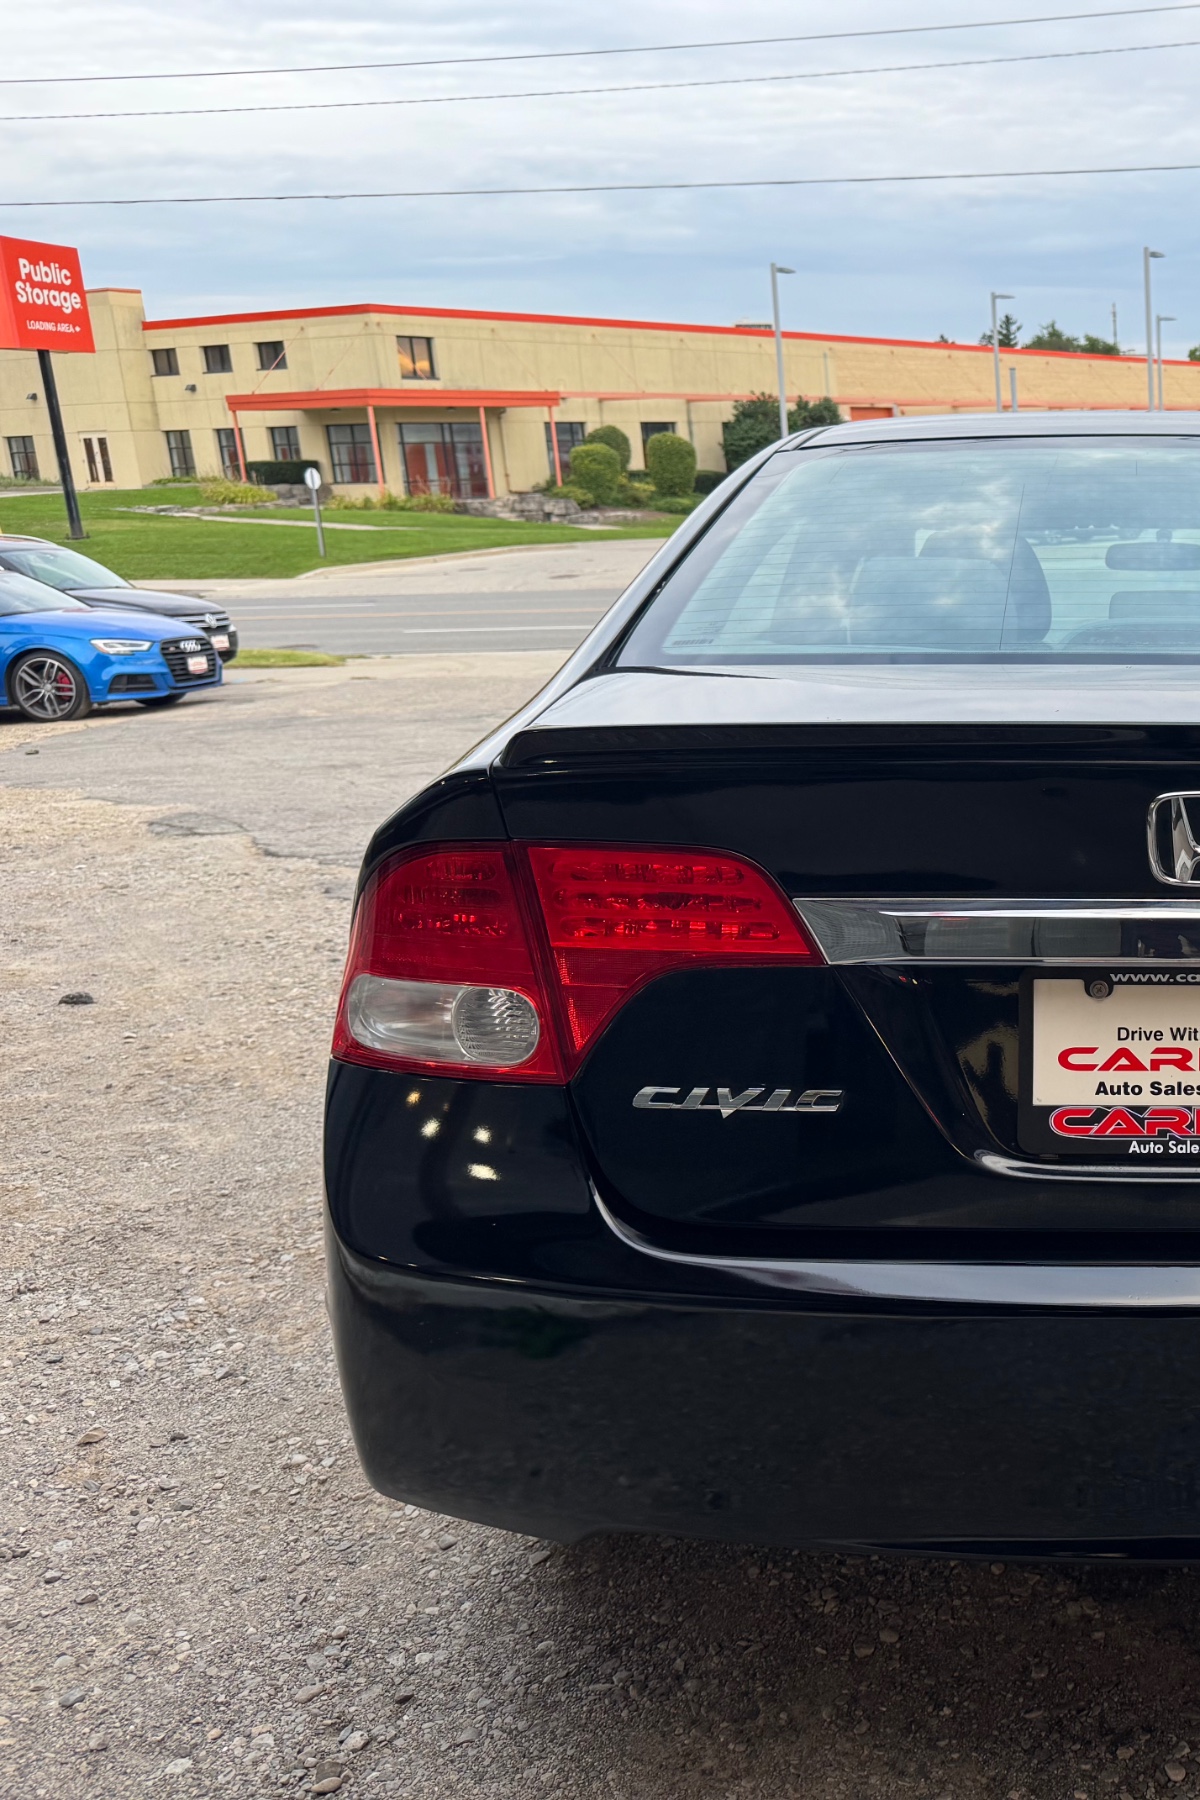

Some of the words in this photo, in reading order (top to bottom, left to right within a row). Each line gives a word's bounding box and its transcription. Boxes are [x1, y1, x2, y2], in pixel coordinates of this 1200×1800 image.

[18, 257, 71, 285] Public
[15, 280, 82, 314] Storage
[26, 320, 56, 332] LOADING
[57, 322, 75, 333] AREA
[1117, 1027, 1164, 1042] Drive
[1095, 1082, 1144, 1096] Auto
[632, 1086, 843, 1119] CIVIC
[1128, 1141, 1165, 1155] Auto
